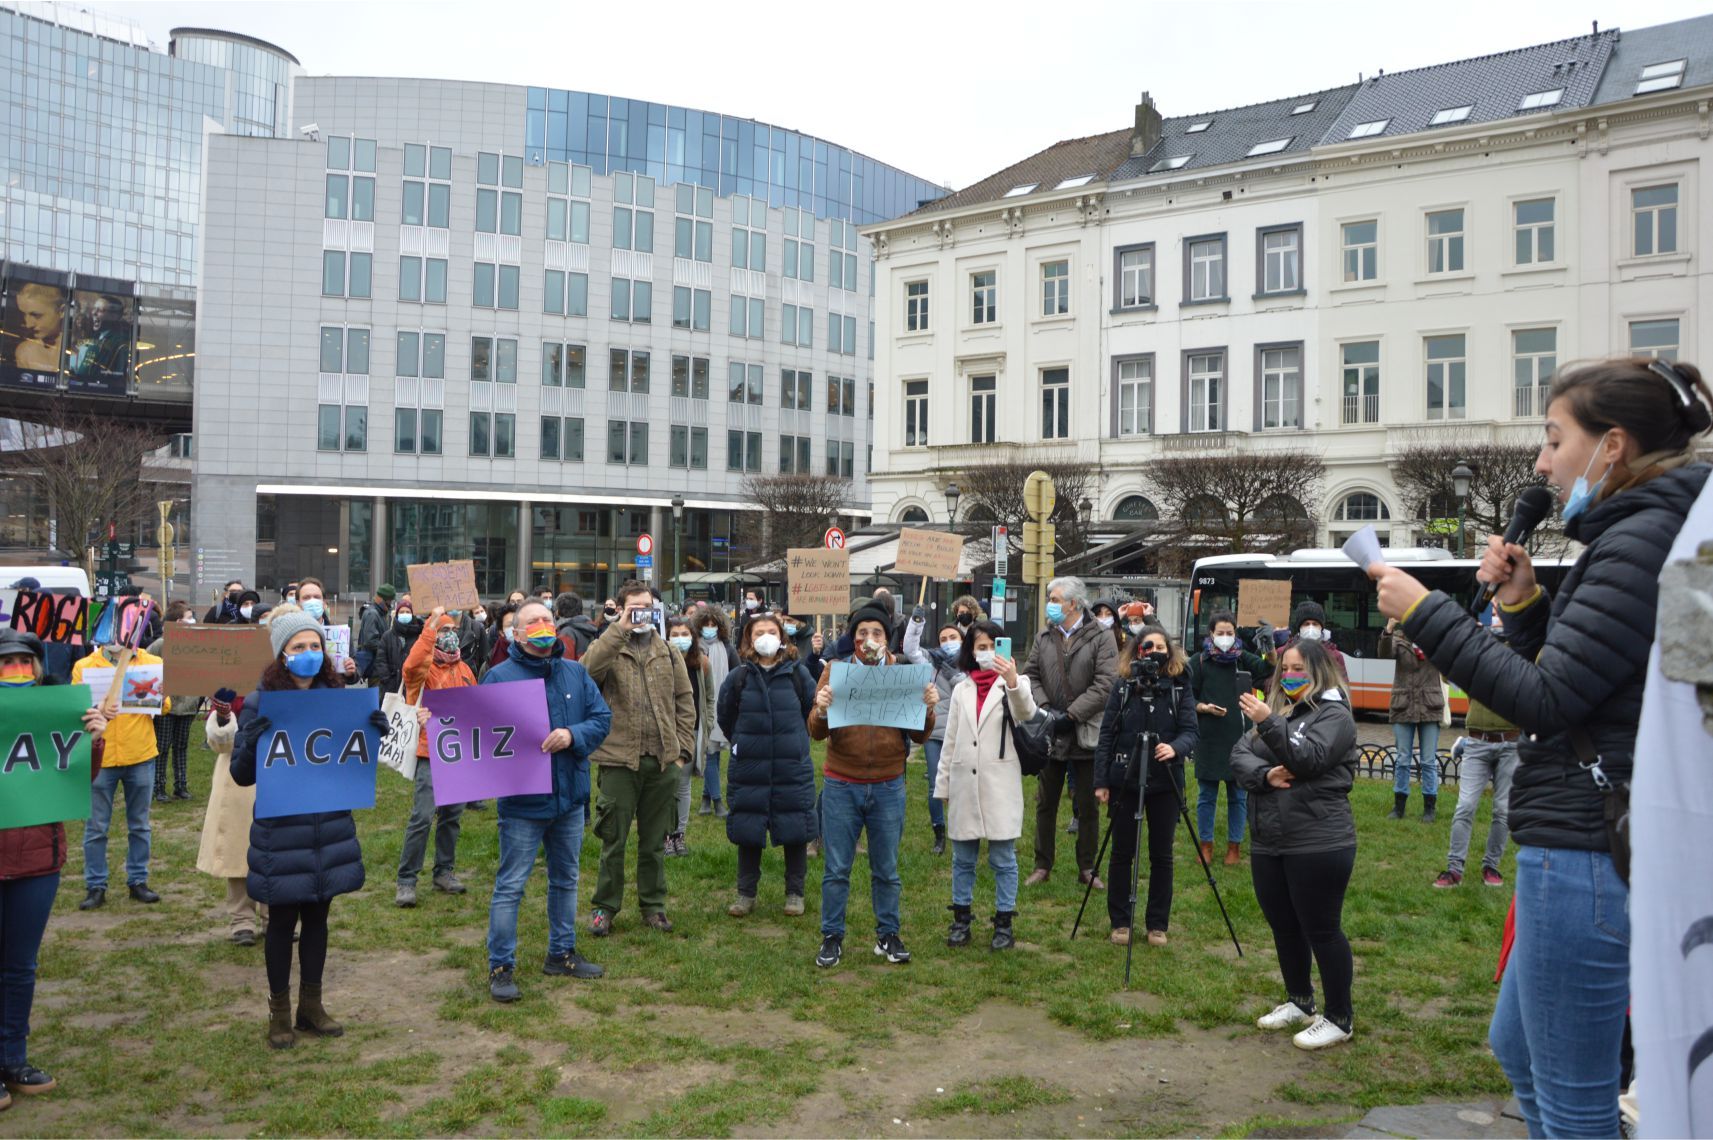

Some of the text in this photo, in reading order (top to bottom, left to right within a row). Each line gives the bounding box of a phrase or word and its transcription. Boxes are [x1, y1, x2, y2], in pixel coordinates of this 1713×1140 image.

[1198, 577, 1215, 585] 9873
[3, 731, 84, 774] AY
[264, 728, 370, 769] ACA
[436, 716, 516, 765] ĞIZ
